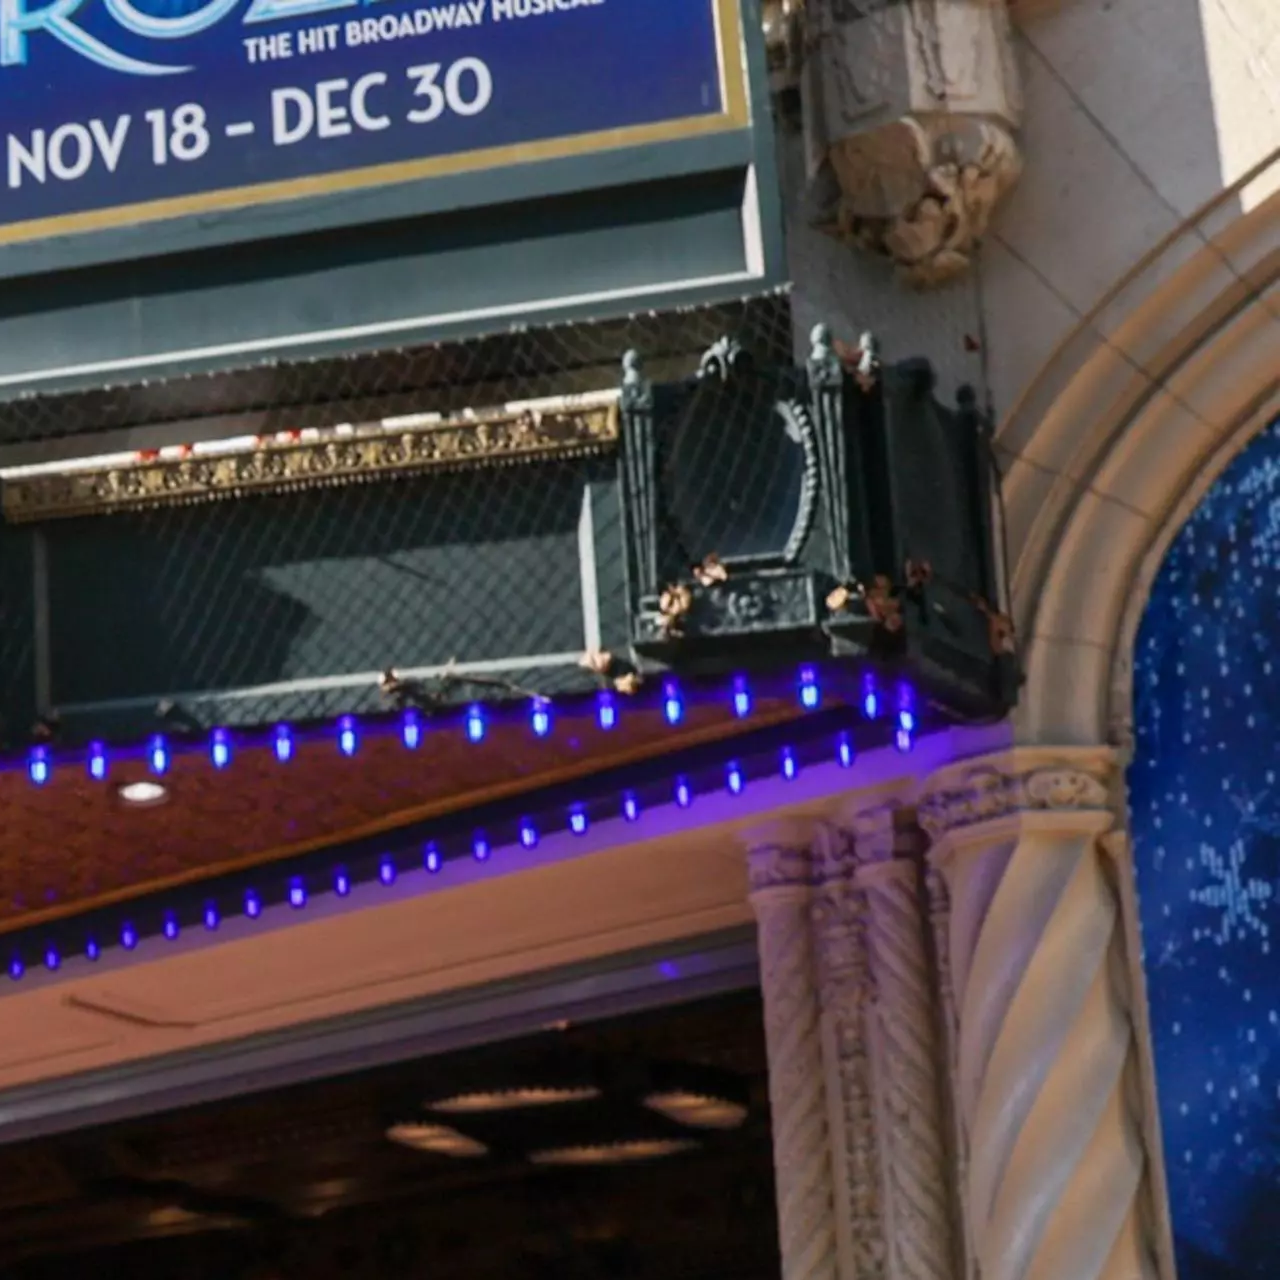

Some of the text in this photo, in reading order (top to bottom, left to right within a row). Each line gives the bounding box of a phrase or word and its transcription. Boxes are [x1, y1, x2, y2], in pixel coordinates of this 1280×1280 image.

[244, 32, 292, 63] THE
[298, 24, 339, 55] HIT
[345, 0, 486, 47] BROADWAY
[7, 113, 131, 188] NOV
[145, 103, 210, 165] 18
[271, 72, 392, 146] DEC
[406, 57, 493, 123] 30
